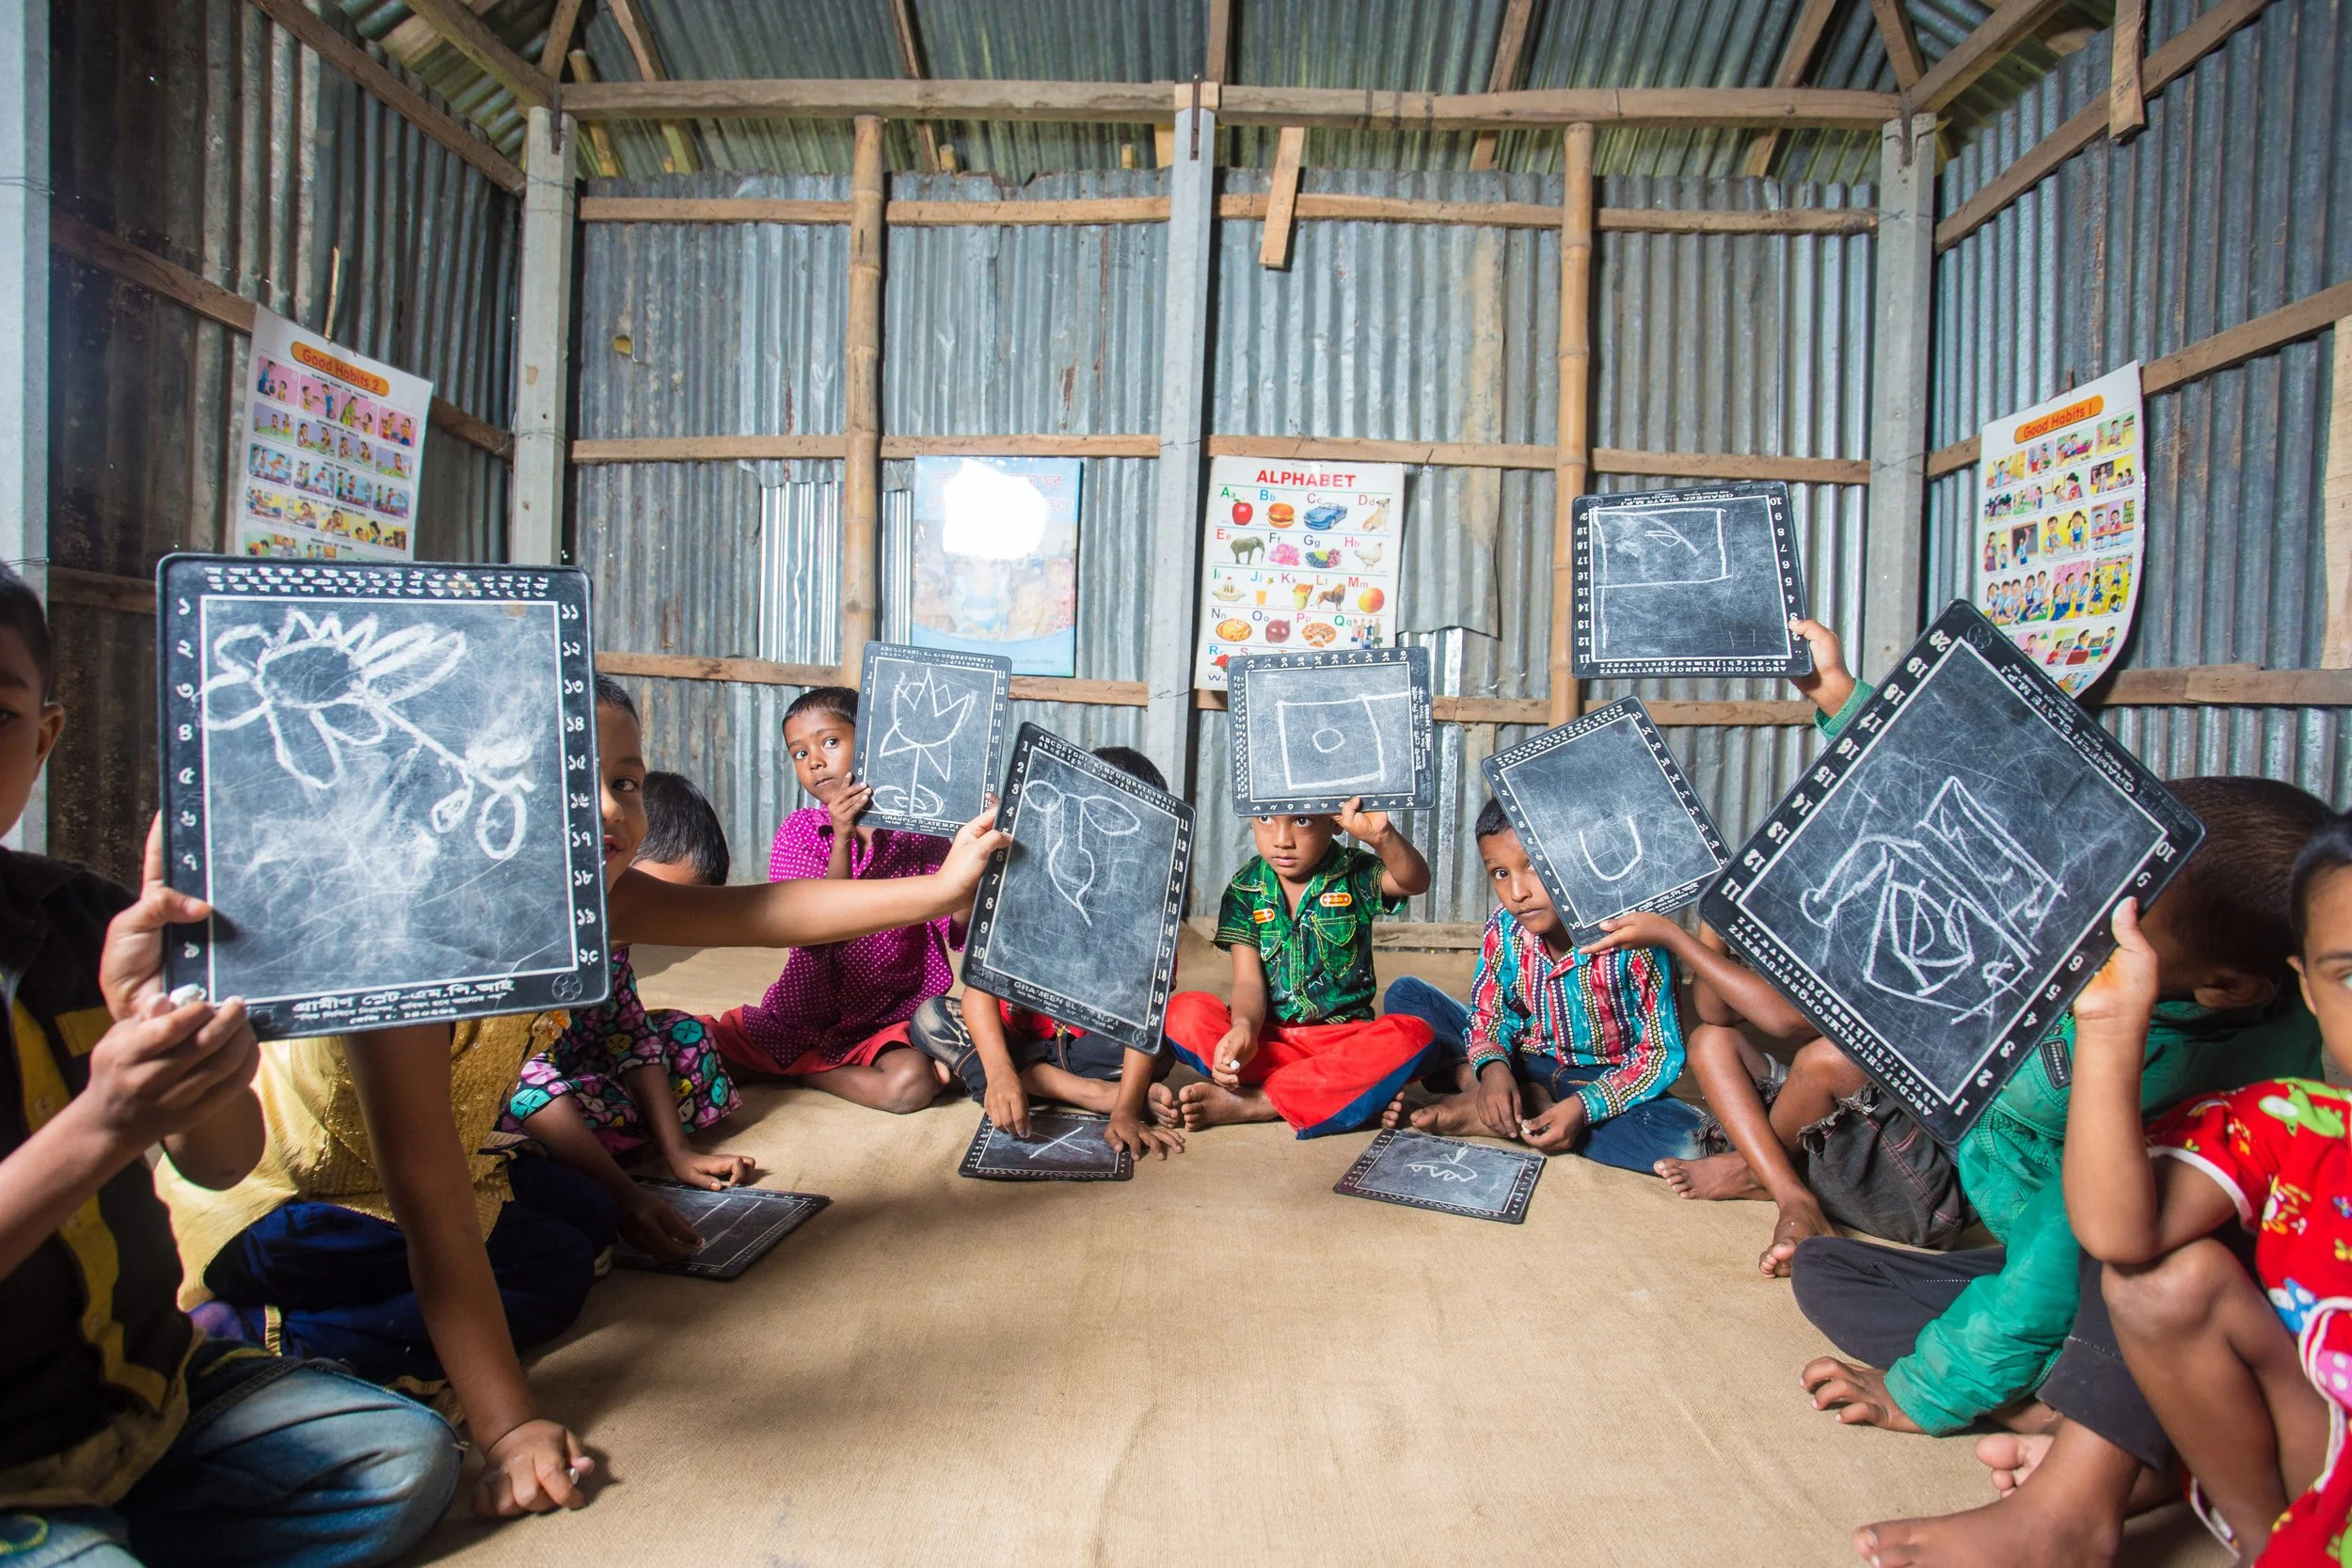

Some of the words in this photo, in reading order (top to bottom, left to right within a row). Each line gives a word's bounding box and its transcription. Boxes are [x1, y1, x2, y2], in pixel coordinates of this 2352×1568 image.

[303, 349, 332, 372] Good
[336, 363, 370, 388] Habits
[373, 379, 379, 391] 2
[2024, 416, 2049, 438] Good
[2052, 403, 2086, 428] Habits
[1256, 469, 1356, 487] ALPHABET
[1770, 498, 1782, 506] 10
[1774, 513, 1783, 521] 9
[1577, 527, 1587, 535] 19
[1776, 528, 1785, 536] 8
[1577, 542, 1588, 550] 18
[1780, 544, 1788, 552] 7
[1578, 556, 1588, 564] 17
[1782, 560, 1789, 569] 6
[1578, 572, 1589, 580] 16
[1785, 577, 1793, 587] 5
[1578, 588, 1589, 596] 15
[1787, 594, 1795, 604] 4
[178, 598, 191, 615] ১
[561, 604, 579, 620] ১১
[1578, 603, 1589, 612] 14
[1578, 620, 1590, 628] 13
[1578, 637, 1590, 646] 12
[1792, 632, 1801, 641] 2
[1930, 629, 1952, 653] 20
[177, 640, 194, 657] ২
[563, 641, 581, 657] ১২
[1579, 654, 1590, 663] 11
[1907, 657, 1929, 679] 19
[176, 683, 194, 698] ৩
[564, 679, 584, 694] ১৩
[1883, 683, 1906, 705] 18
[2030, 694, 2073, 735] SLATE
[566, 716, 585, 733] ১৪
[1859, 712, 1883, 733] 17
[178, 723, 193, 741] ৪
[1023, 741, 1028, 752] 1
[1836, 736, 1860, 761] 16
[567, 754, 586, 770] ১৫
[1017, 762, 1025, 773] 2
[179, 768, 196, 784] ৫
[1814, 765, 1836, 788] 15
[1012, 784, 1020, 795] 3
[570, 793, 590, 809] ১৬
[1791, 793, 1814, 816] 14
[181, 811, 197, 827] ৬
[1007, 807, 1014, 817] 4
[1180, 819, 1189, 832] 11
[1767, 821, 1789, 845] 13
[572, 832, 592, 847] ১৭
[1177, 838, 1187, 853] 12
[995, 850, 1004, 862] 6
[2155, 841, 2177, 863] 10
[183, 854, 198, 871] ৭
[1174, 859, 1184, 873] 13
[1743, 848, 1766, 873] 12
[574, 870, 594, 887] ১৮
[992, 874, 999, 885] 7
[2137, 871, 2153, 888] 9
[1170, 880, 1180, 894] 14
[1721, 878, 1742, 902] 11
[985, 897, 993, 910] 8
[1168, 901, 1177, 915] 15
[577, 909, 596, 926] ১৯
[979, 921, 989, 934] 9
[1165, 923, 1174, 937] 16
[973, 945, 985, 960] 10
[1160, 945, 1170, 958] 17
[2069, 955, 2084, 972] 6
[1157, 968, 1167, 982] 18
[1153, 990, 1164, 1005] 19
[2045, 984, 2061, 1001] 5
[2024, 1010, 2039, 1028] 4
[1999, 1040, 2016, 1058] 3
[1977, 1069, 1994, 1088] 2
[1954, 1098, 1970, 1117] 1
